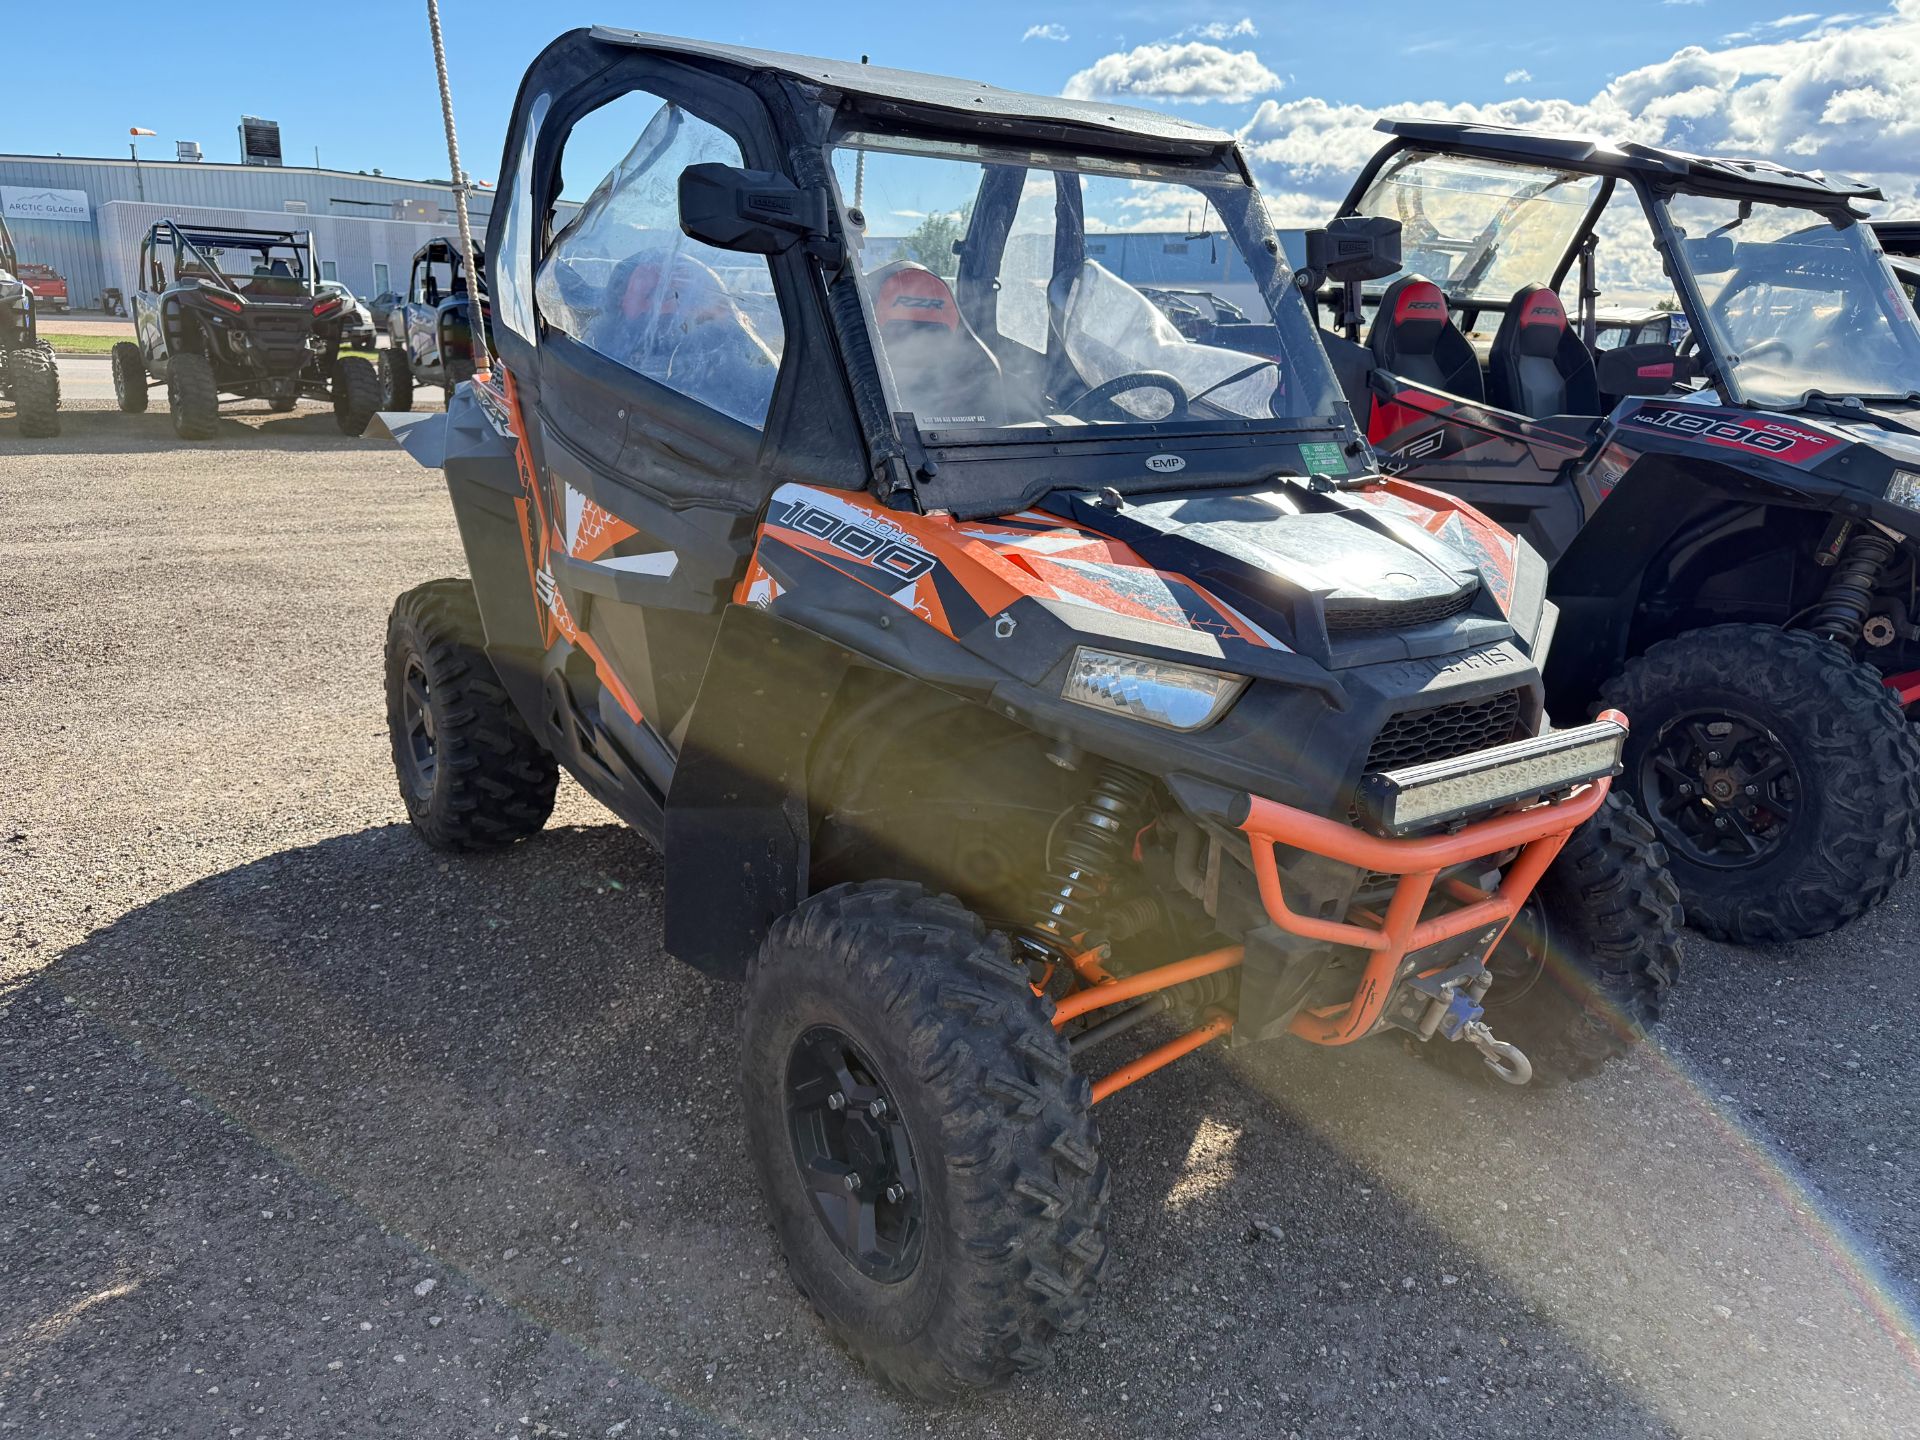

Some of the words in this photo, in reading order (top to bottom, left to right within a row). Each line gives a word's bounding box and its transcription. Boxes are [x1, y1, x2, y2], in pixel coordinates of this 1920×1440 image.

[9, 203, 43, 211] ARCTIC
[46, 205, 85, 213] GLACIER
[892, 295, 944, 310] RZR
[1407, 301, 1440, 310] RZR
[1530, 306, 1559, 316] RZR
[1653, 410, 1797, 452] 1000
[1763, 424, 1828, 445] DOHC
[1151, 458, 1180, 468] EMP
[862, 516, 920, 548] DOHC
[779, 498, 937, 582] 1000
